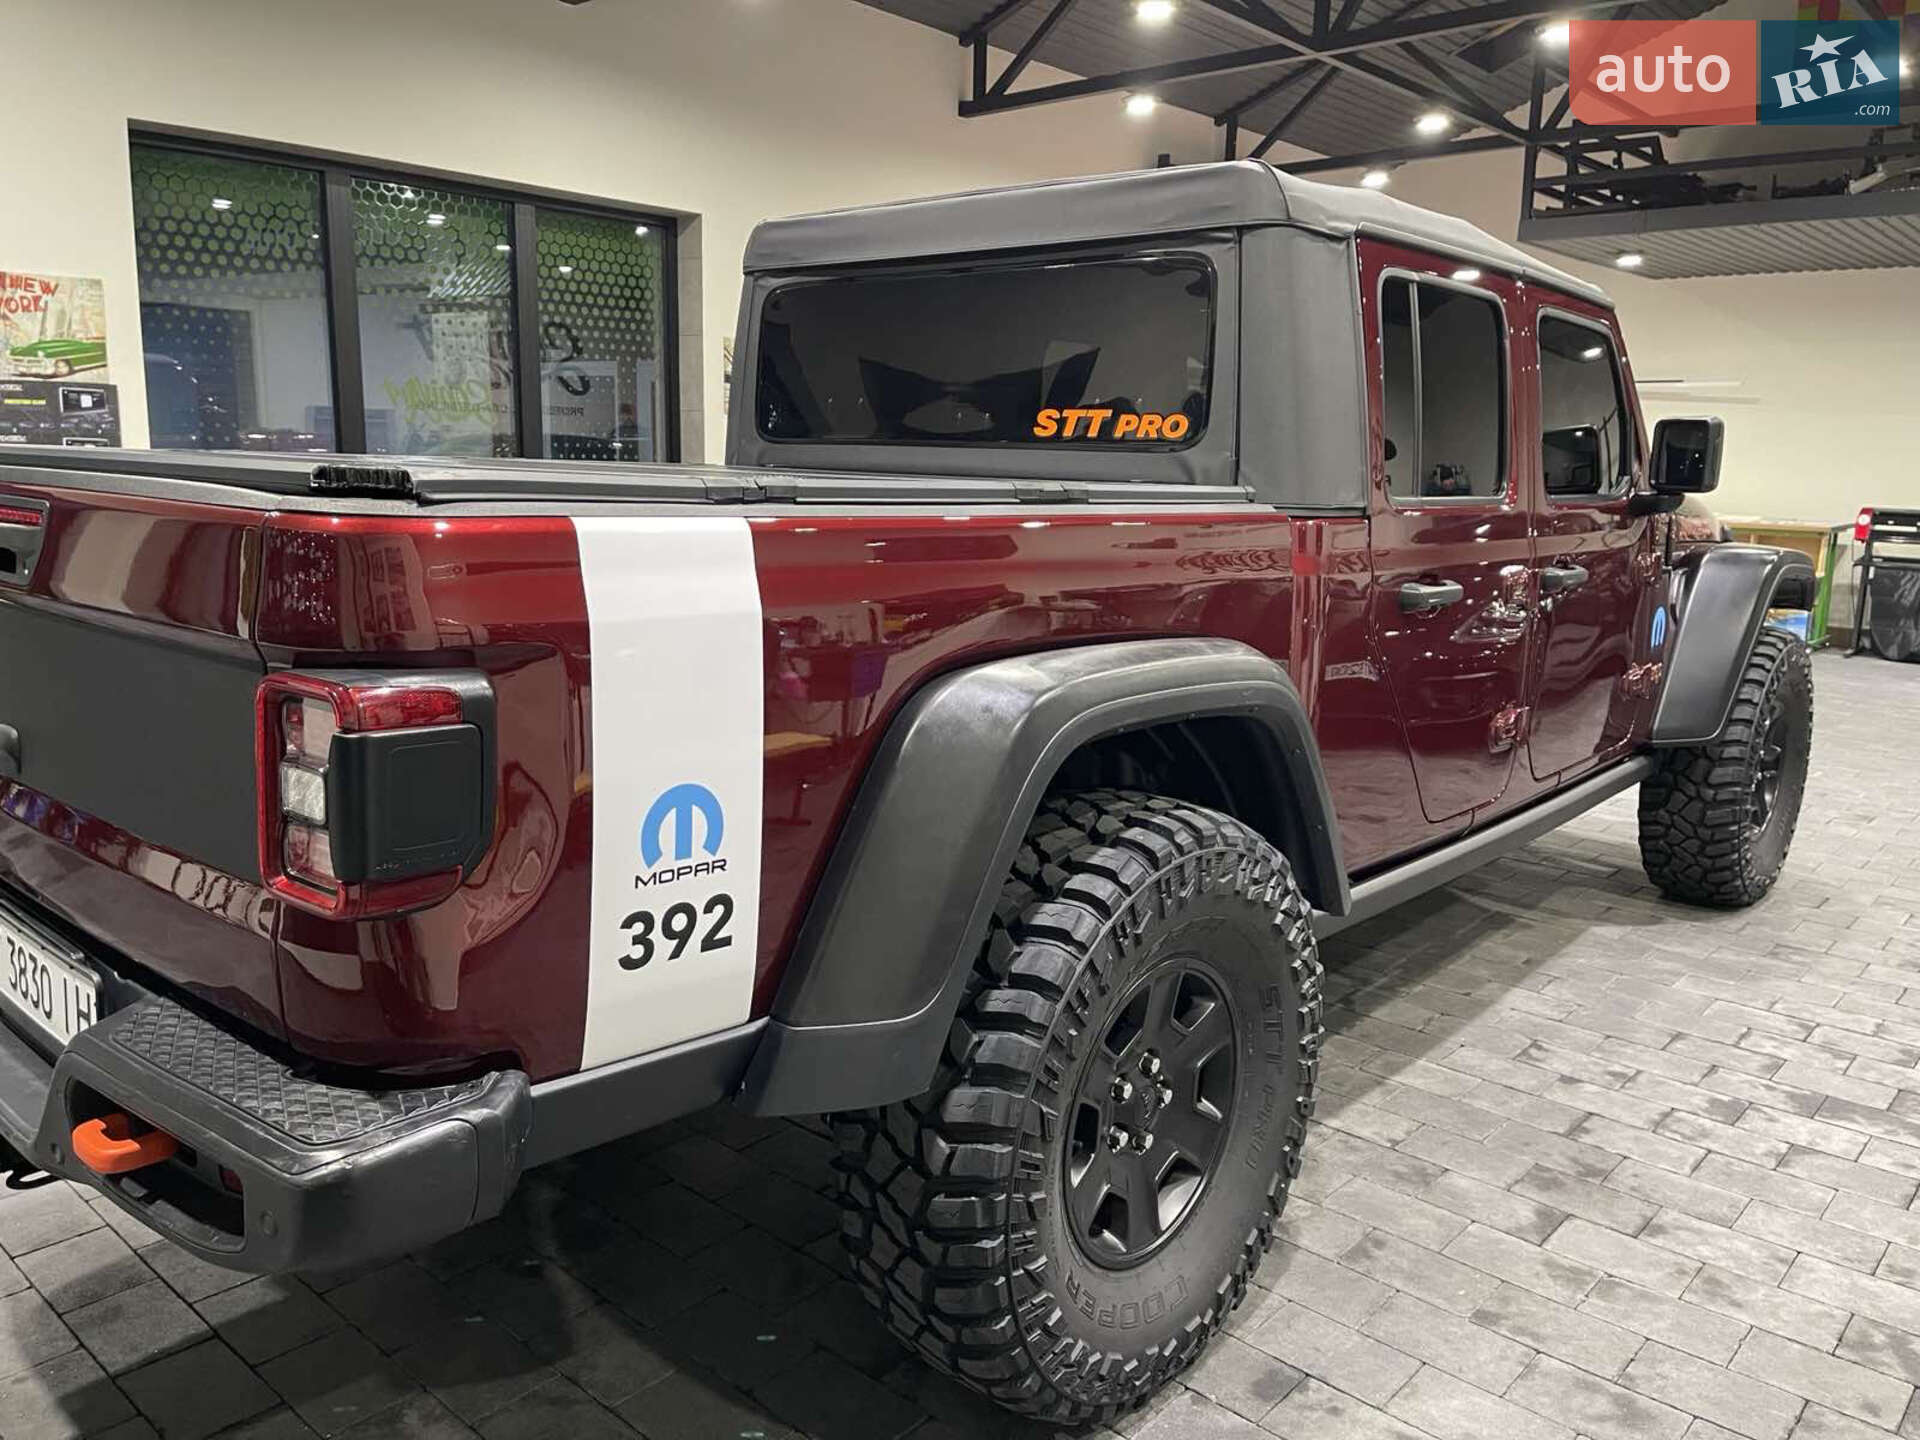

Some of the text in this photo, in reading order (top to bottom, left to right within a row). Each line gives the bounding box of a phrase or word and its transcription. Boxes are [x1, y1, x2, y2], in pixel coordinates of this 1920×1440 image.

[1033, 408, 1189, 439] STT PRO
[634, 858, 728, 889] MOPAR
[618, 893, 734, 971] 392
[7, 934, 52, 1020] 3830
[1064, 1269, 1190, 1331] COOPER
